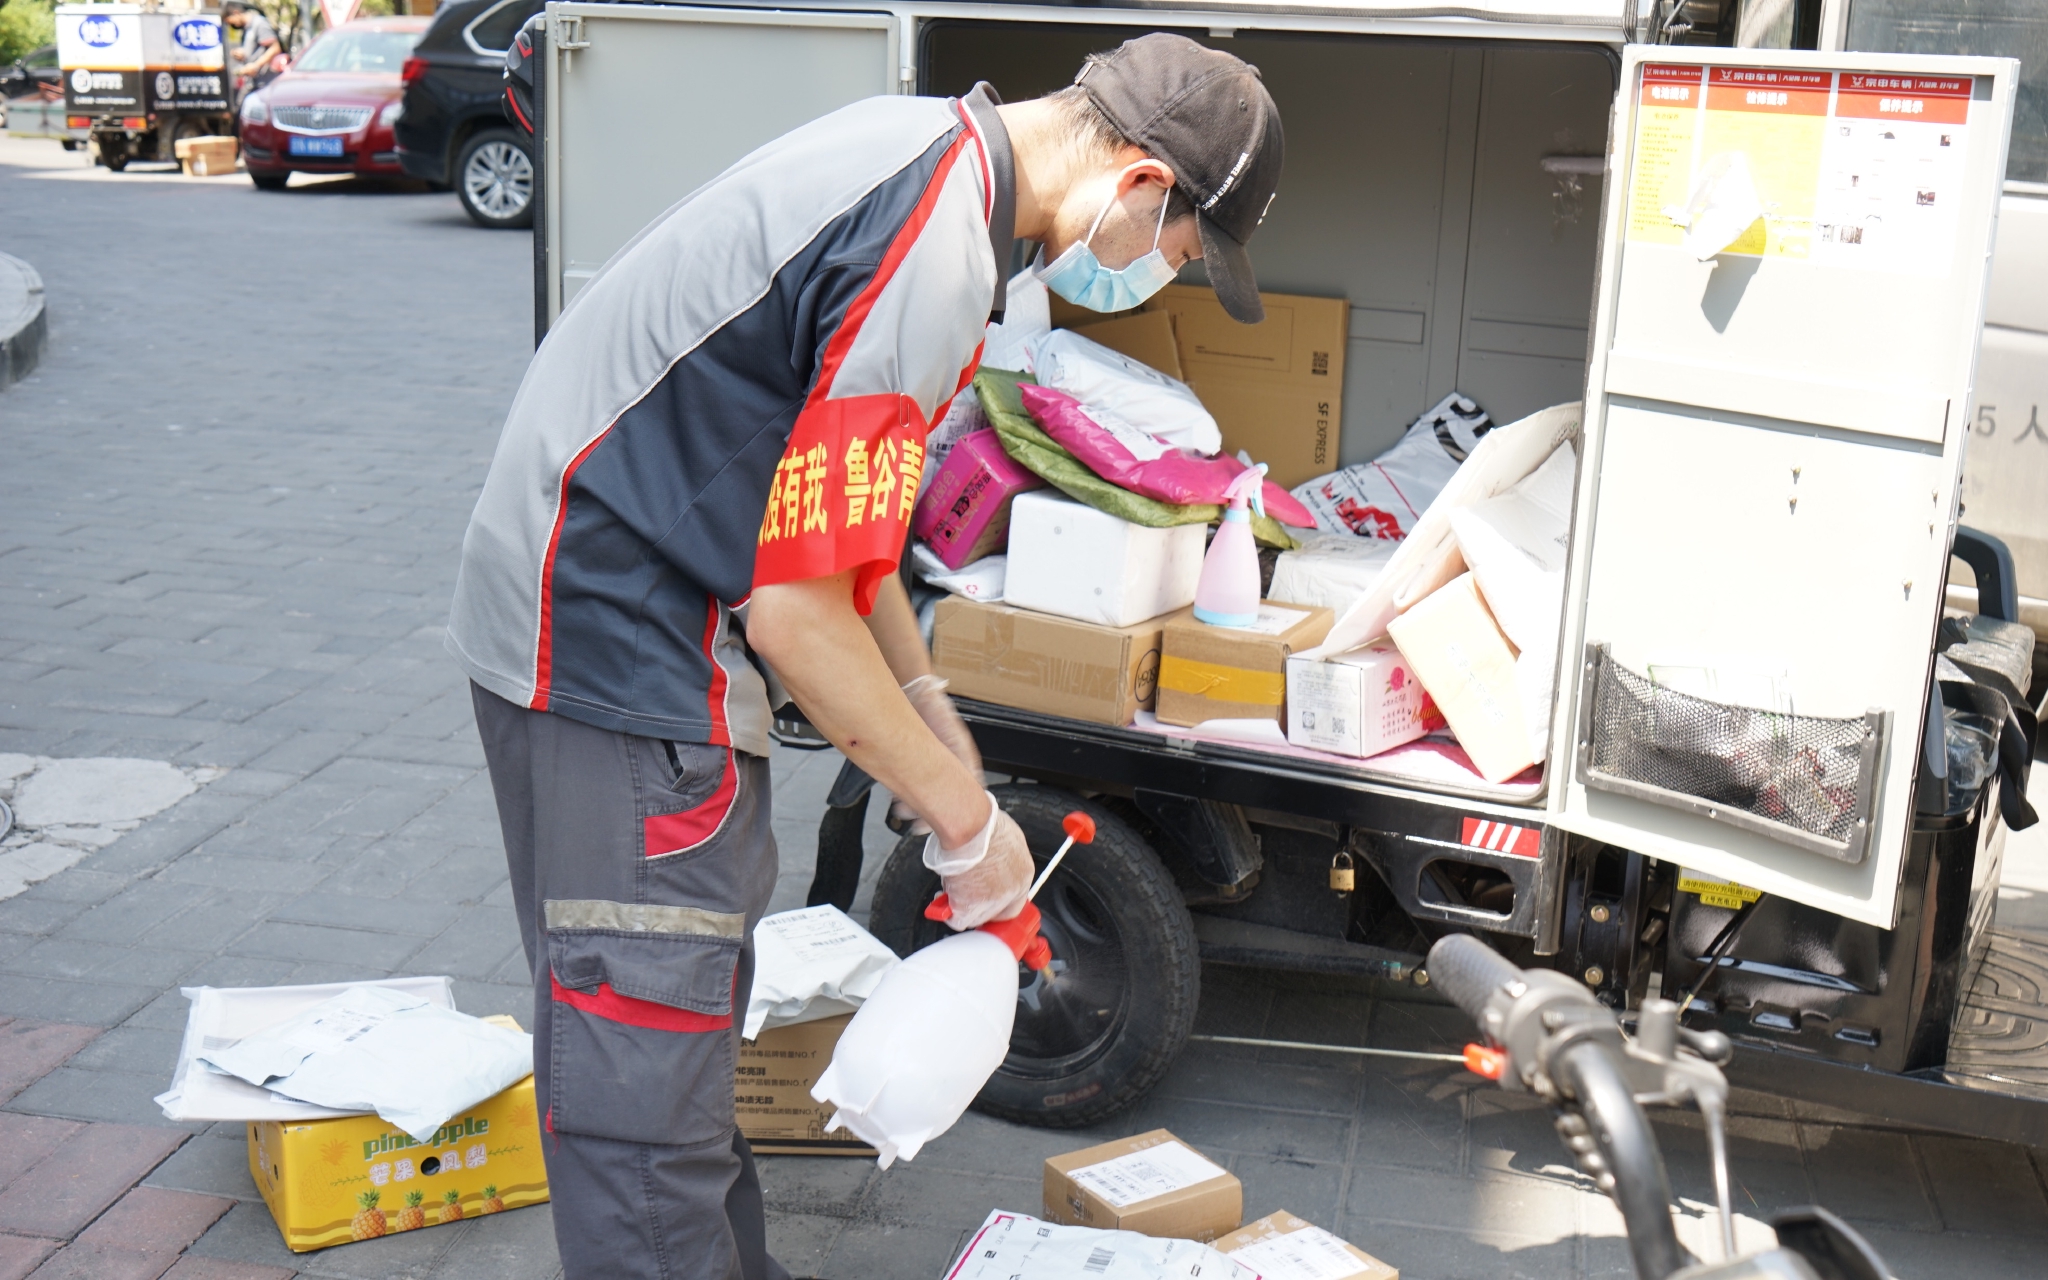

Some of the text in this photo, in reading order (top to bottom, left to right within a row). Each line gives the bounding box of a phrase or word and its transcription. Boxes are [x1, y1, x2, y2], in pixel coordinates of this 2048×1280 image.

[1733, 72, 1777, 83] 宗申车辆
[1865, 78, 1913, 90] 宗申车辆
[1879, 98, 1924, 114] 保养提示
[1218, 174, 1235, 198] NEVER
[1314, 402, 1329, 465] SF EXPRESS
[924, 469, 956, 511] 唯品会
[363, 1116, 490, 1161] pinepple
[369, 1143, 488, 1187] 芒果 凤梨
